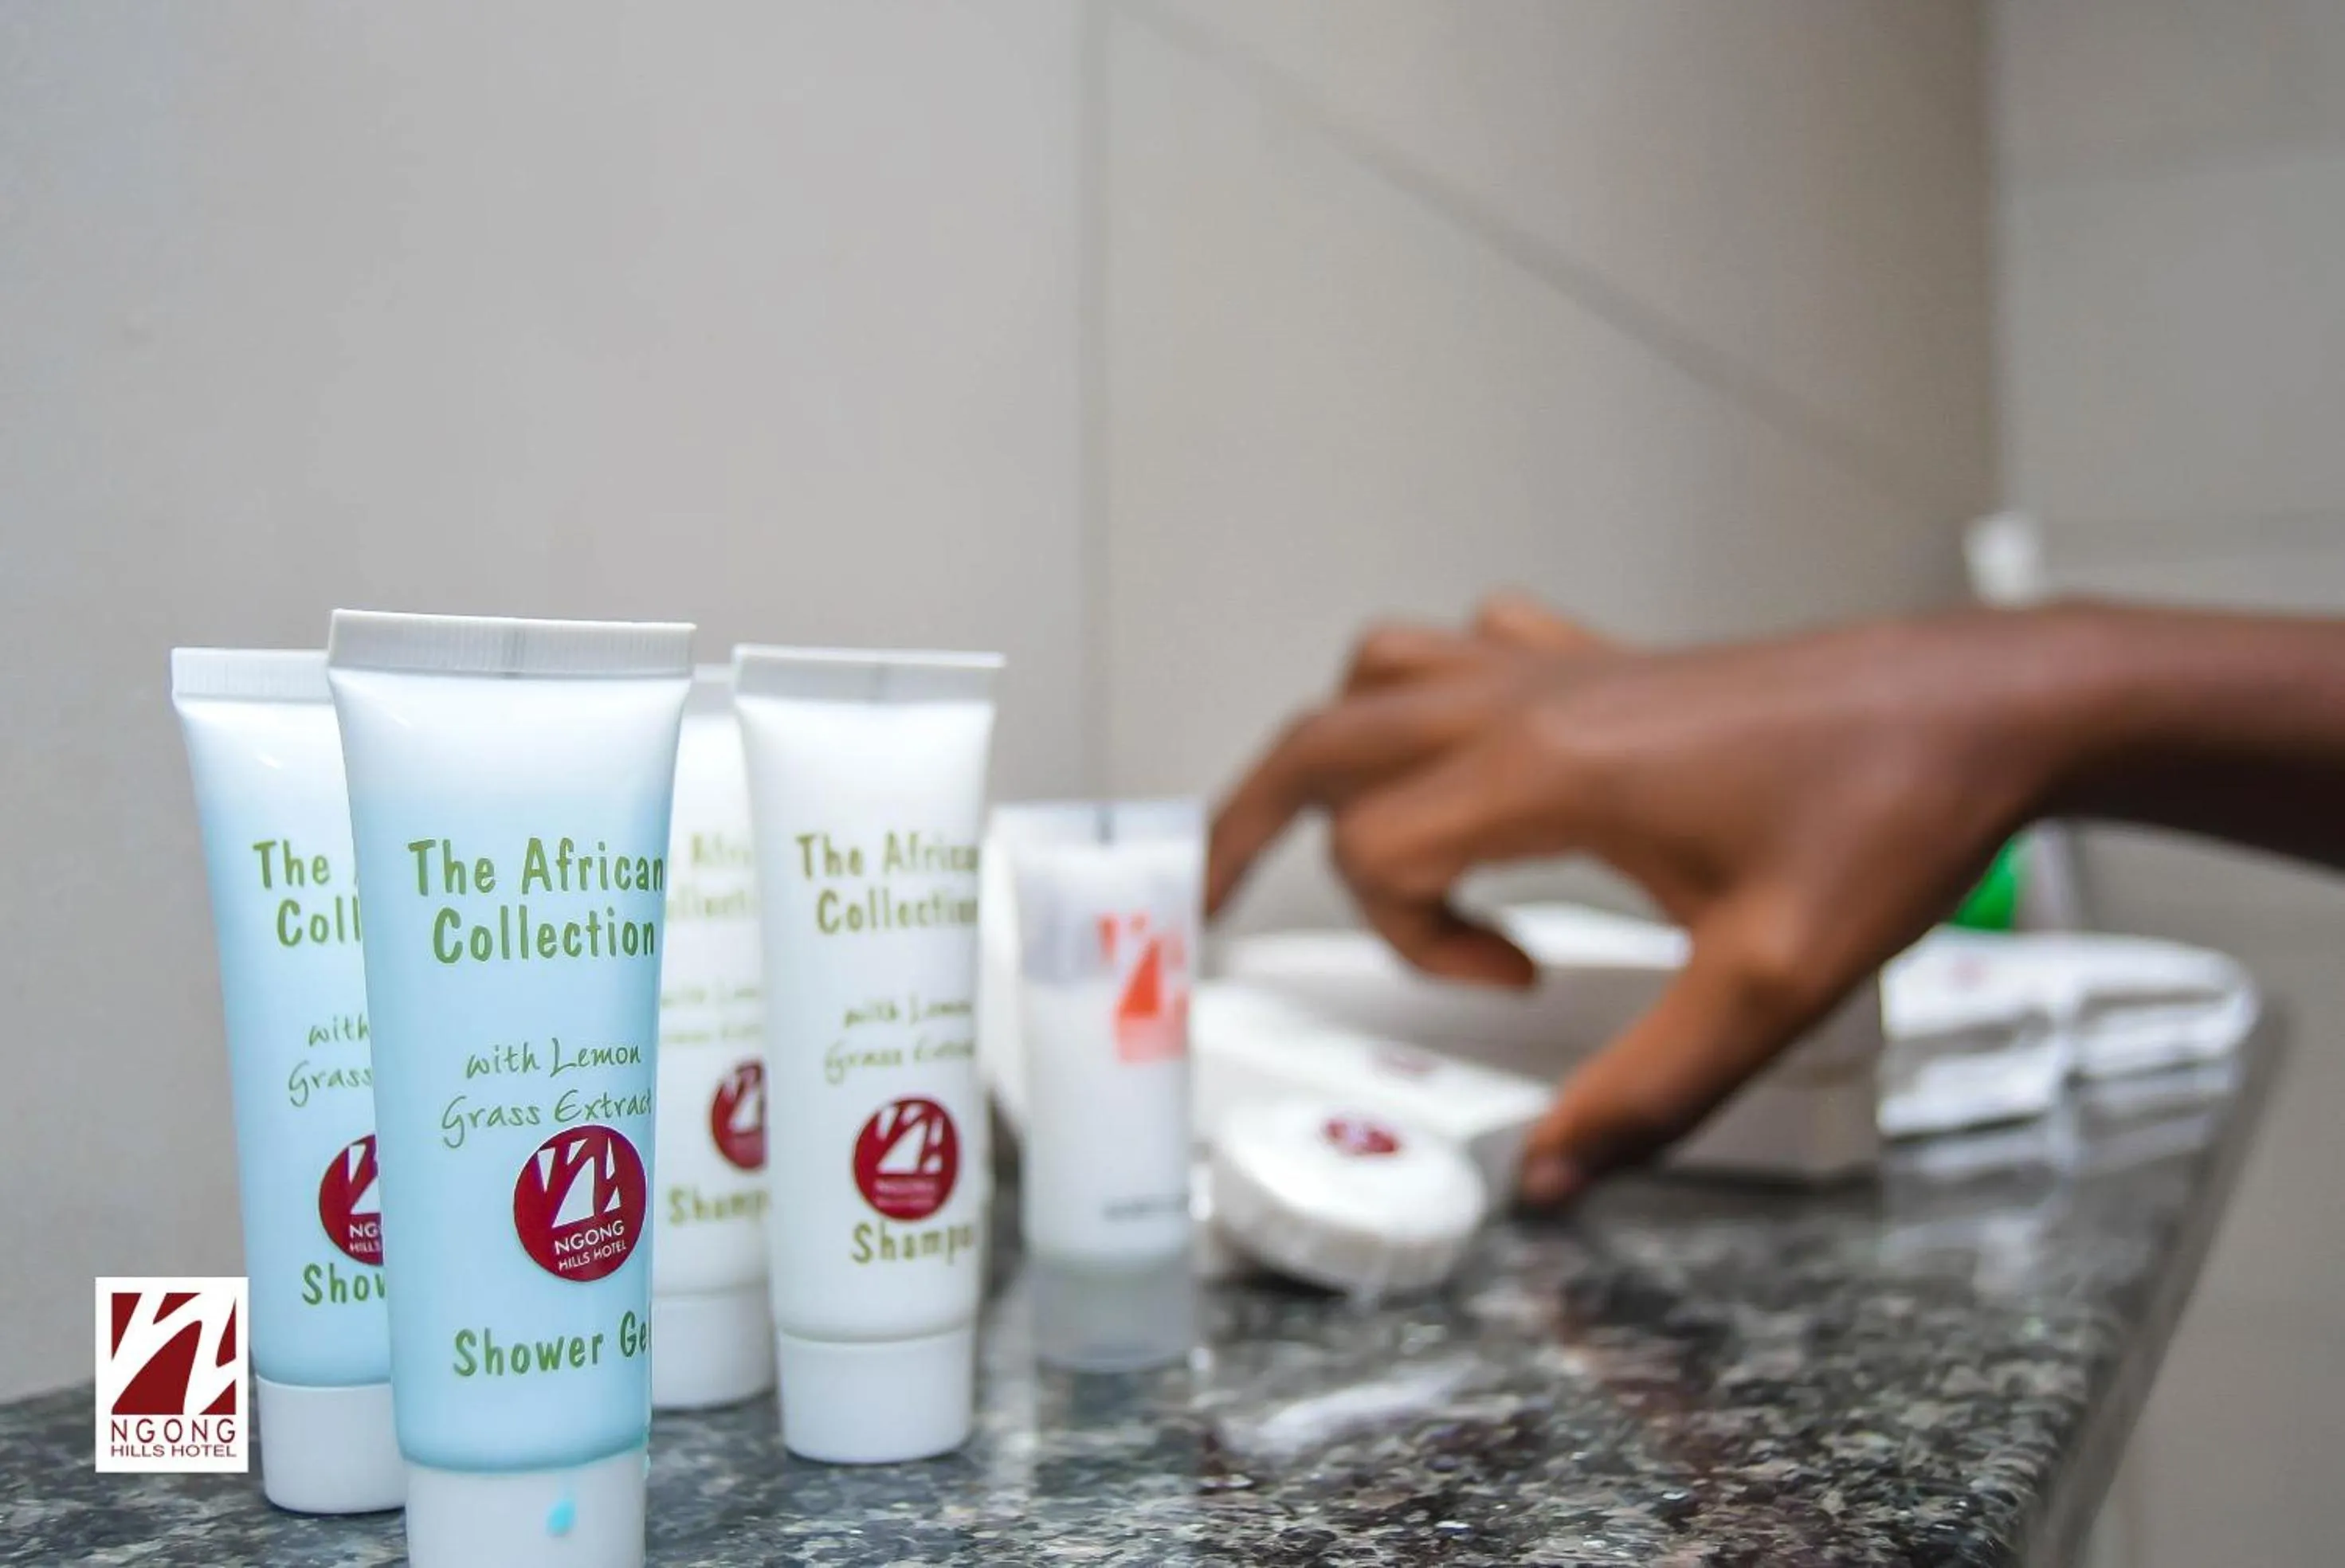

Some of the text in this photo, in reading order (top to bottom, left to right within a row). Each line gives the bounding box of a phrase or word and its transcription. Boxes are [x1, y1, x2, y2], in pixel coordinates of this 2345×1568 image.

[252, 839, 331, 890] The
[408, 837, 665, 896] The African
[795, 833, 864, 880] The
[433, 904, 655, 964] Collection
[308, 1013, 370, 1047] with
[466, 1037, 641, 1080] with Lemon
[441, 1088, 651, 1149] Grass Extract
[555, 1220, 625, 1255] NGONG
[559, 1239, 627, 1272] HILLS HOTEL
[453, 1327, 604, 1378] Shower
